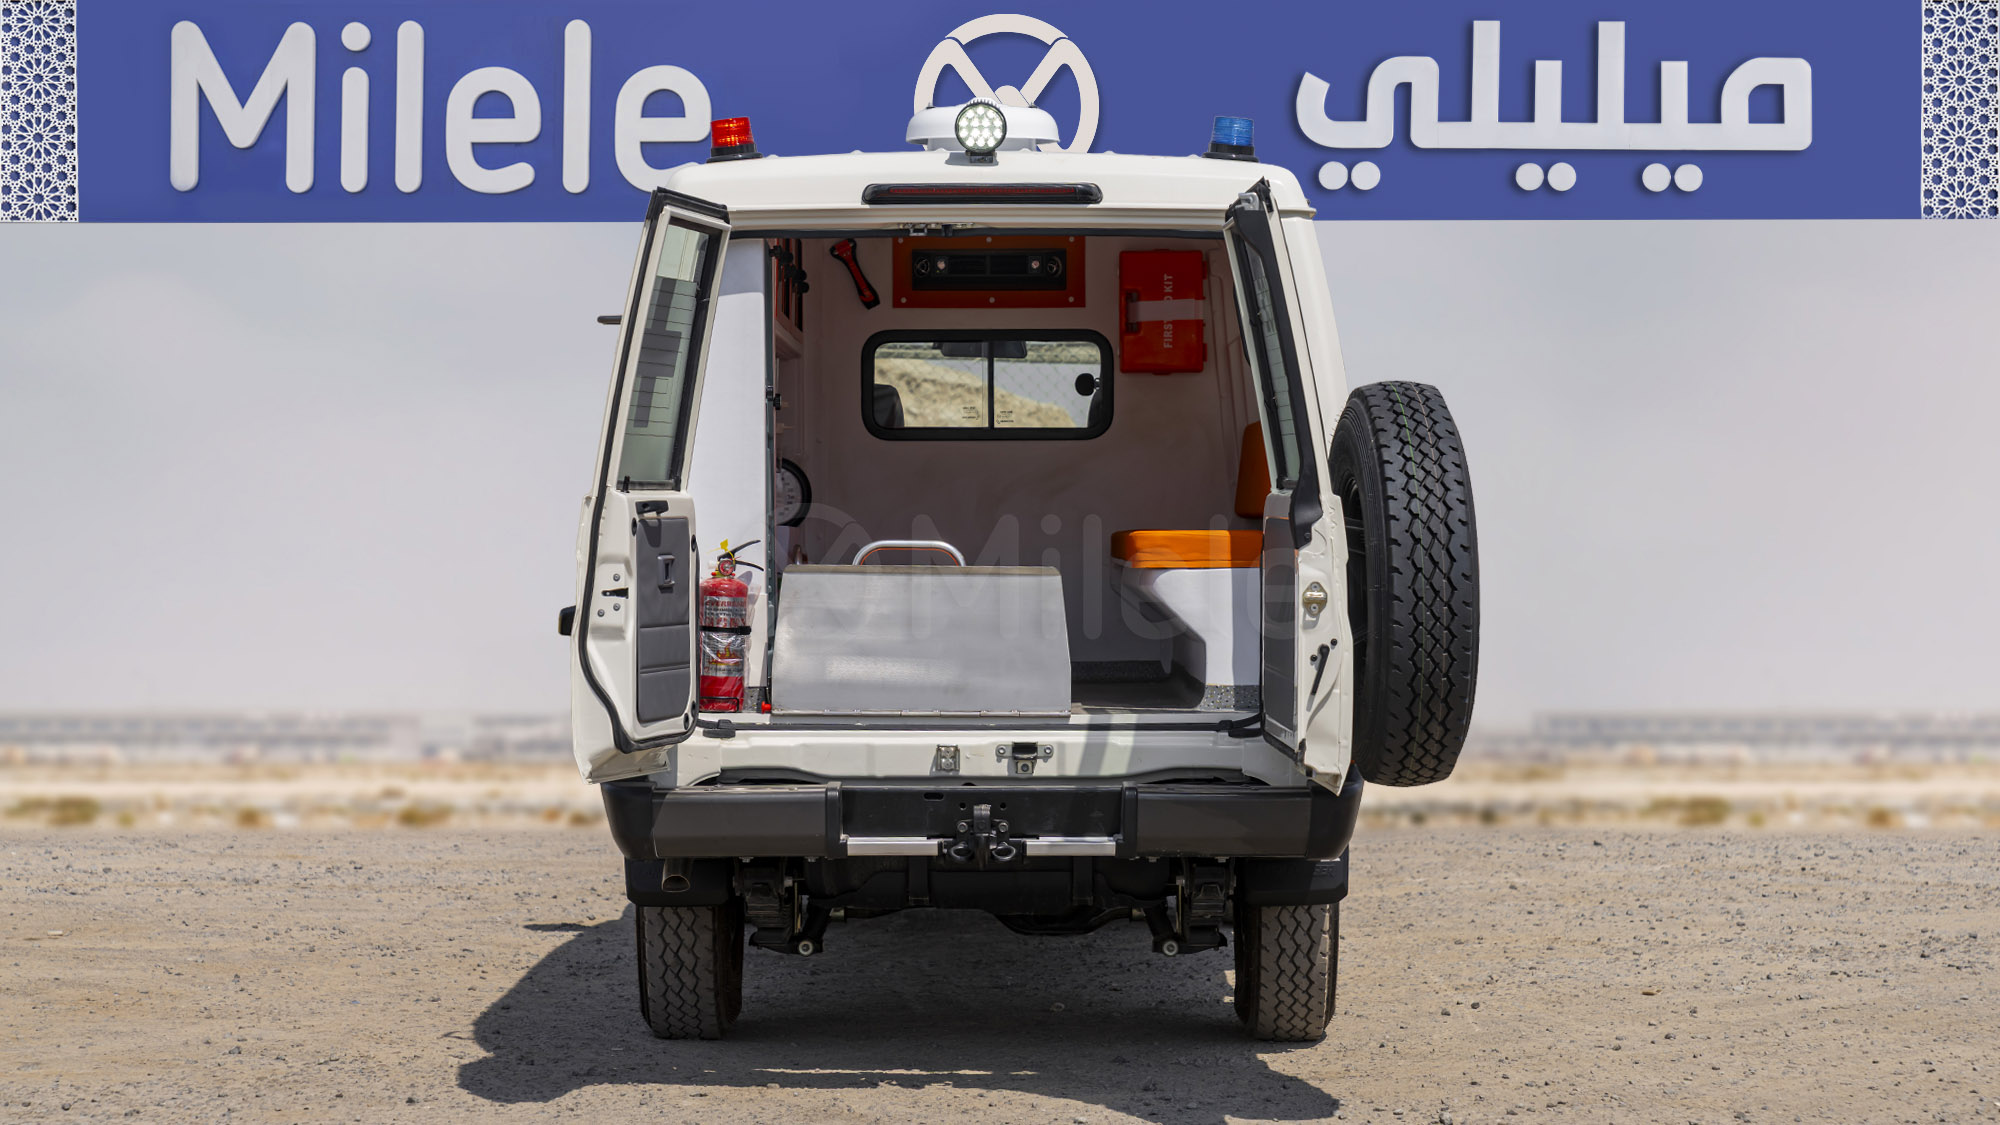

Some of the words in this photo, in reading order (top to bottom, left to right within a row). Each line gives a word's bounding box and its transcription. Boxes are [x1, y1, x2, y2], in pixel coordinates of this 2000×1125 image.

[170, 19, 712, 193] Milele
[1296, 20, 1812, 192] ميليلي
[1164, 273, 1173, 293] KIT
